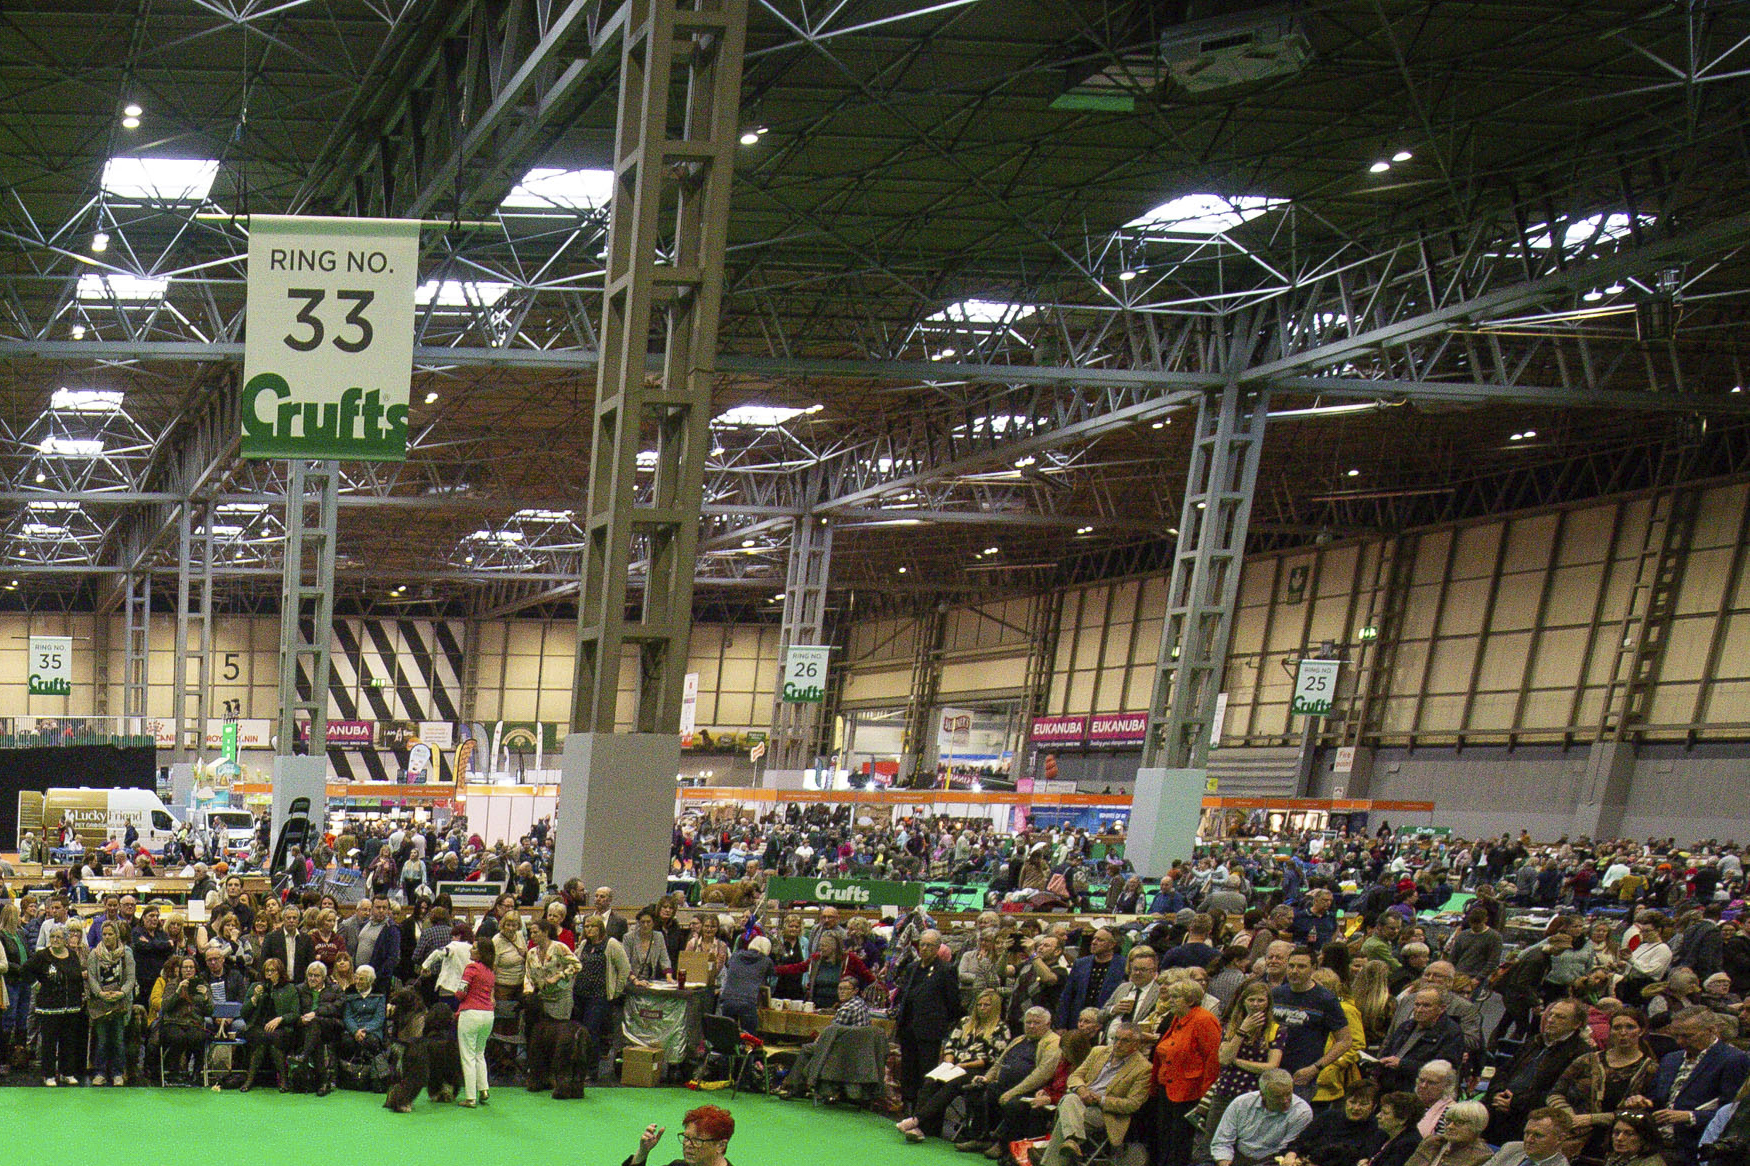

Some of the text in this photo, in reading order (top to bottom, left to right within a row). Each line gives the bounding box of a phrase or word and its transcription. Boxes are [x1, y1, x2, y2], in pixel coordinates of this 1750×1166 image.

[270, 248, 394, 274] RING NO.
[283, 287, 375, 353] 33
[242, 372, 409, 440] Crufts
[39, 653, 62, 669] 35
[223, 653, 240, 680] 5
[794, 662, 818, 677] 26
[29, 674, 71, 690] Crufts
[1304, 676, 1327, 691] 25
[783, 682, 825, 699] Crufts
[1293, 695, 1332, 711] Crufts
[305, 725, 369, 736] EANUBA
[1033, 722, 1082, 735] EUKANUBA
[1092, 719, 1146, 733] EUKANUBA
[75, 809, 142, 823] Lucky Friend
[815, 881, 870, 902] Crufts
